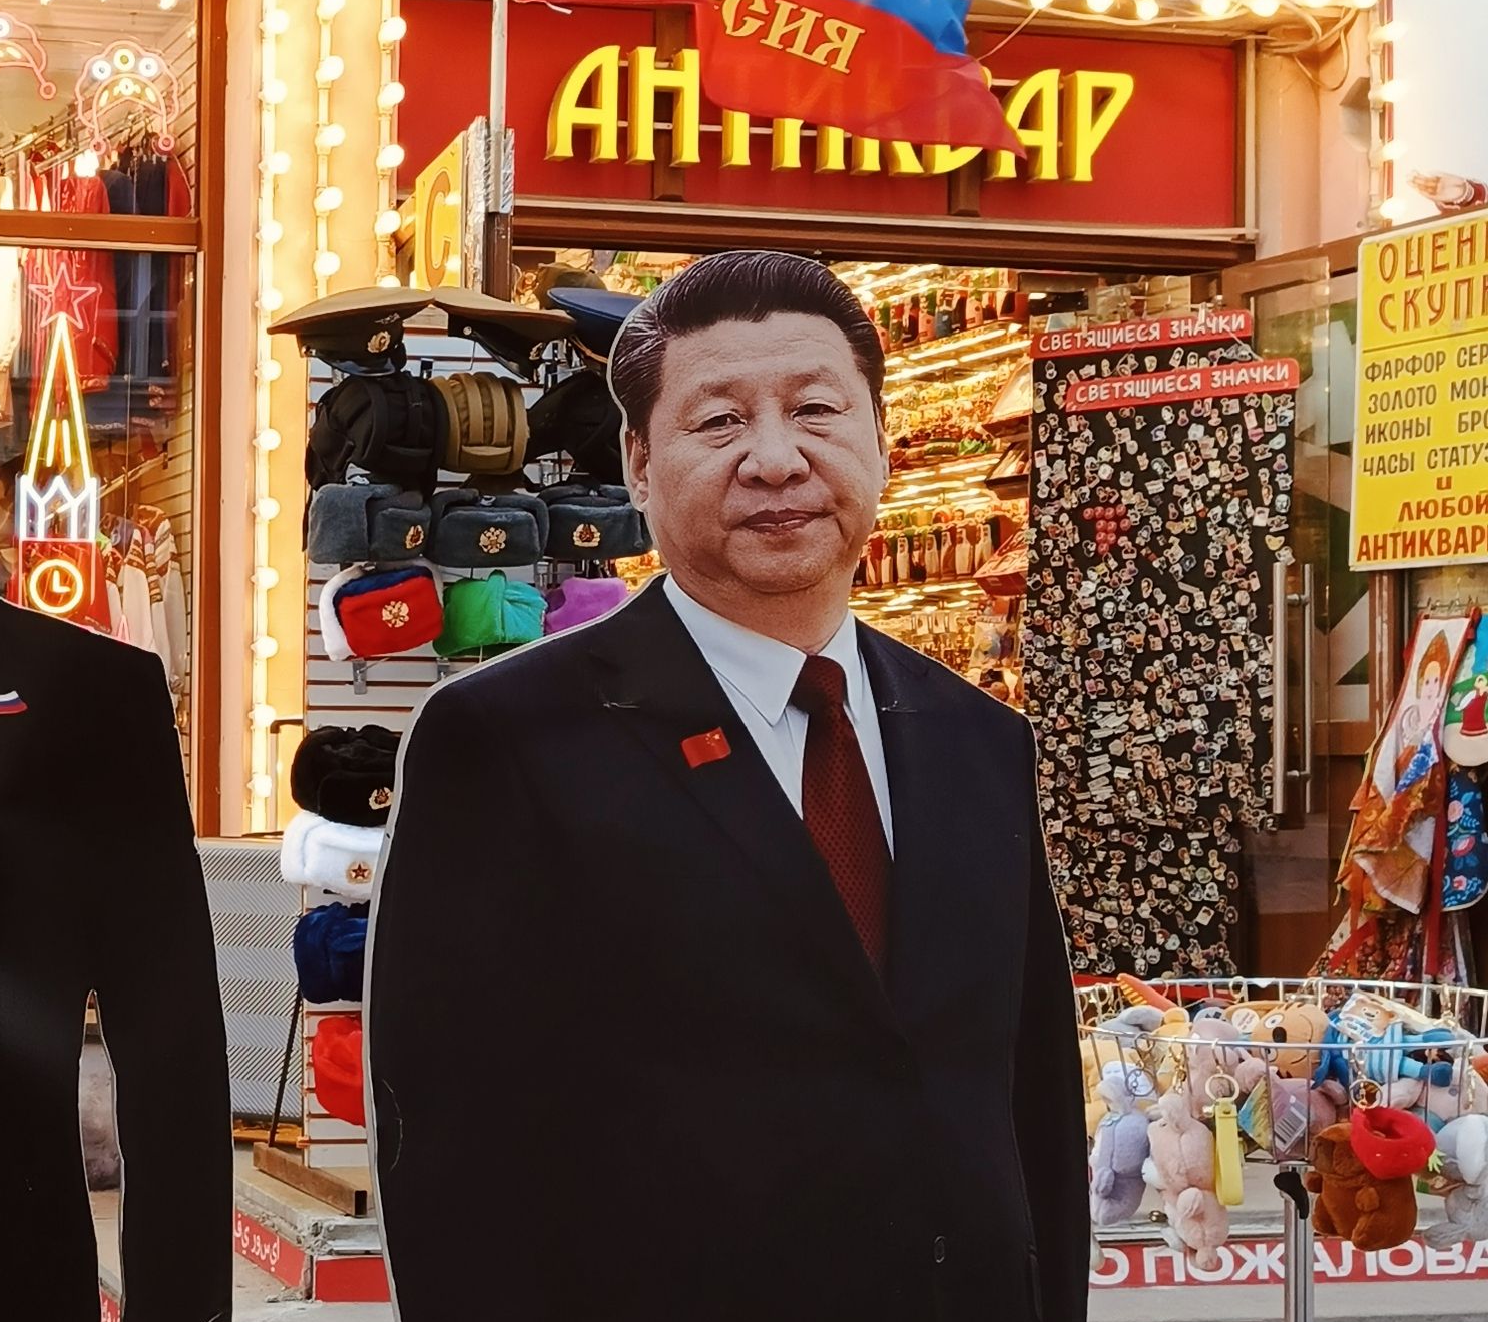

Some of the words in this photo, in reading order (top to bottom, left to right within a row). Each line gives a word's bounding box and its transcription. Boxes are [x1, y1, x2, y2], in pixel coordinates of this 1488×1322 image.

[1379, 221, 1488, 283] ОЦЕН
[1039, 323, 1160, 351] СВЕТЯЩИЕСЯ
[1170, 314, 1245, 338] ЗНАЧКИ
[1075, 372, 1201, 402] СВЕТЯЩИЕСЯ
[1211, 362, 1289, 388] ЗНАЧКИ
[1365, 351, 1446, 382] ФАРФОР
[1368, 384, 1437, 414] ЗОЛОТО
[1365, 417, 1431, 445] ИКОНЫ
[1363, 452, 1415, 476] ЧАСЫ
[1398, 490, 1488, 522] ЛЮБОЙ
[1357, 524, 1488, 562] АНТИКВАР
